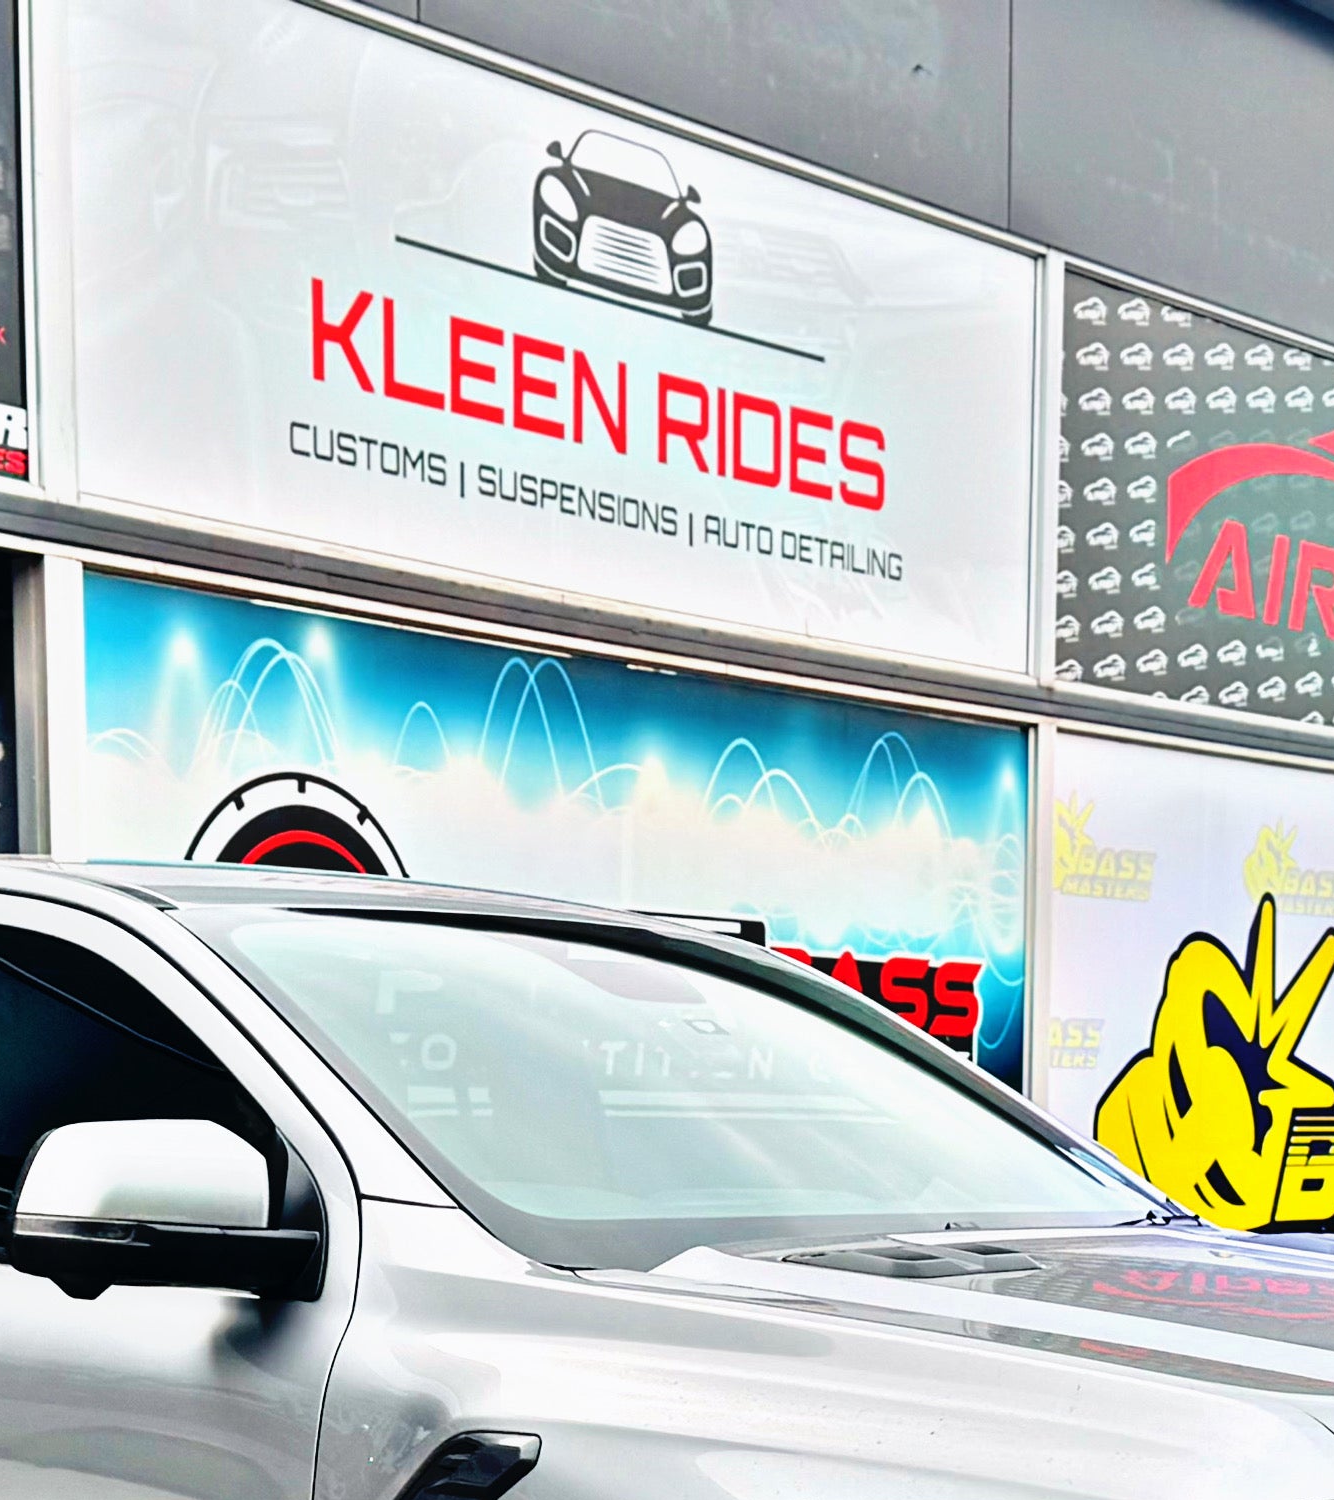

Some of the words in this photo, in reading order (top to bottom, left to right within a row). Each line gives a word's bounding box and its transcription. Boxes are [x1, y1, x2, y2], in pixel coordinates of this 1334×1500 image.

[311, 277, 628, 455] KLEEN
[658, 371, 886, 511] RIDES
[290, 421, 447, 486] CUSTOMS
[478, 464, 677, 536] SUSPENSIONS
[704, 515, 773, 555] AUTO
[781, 530, 903, 581] DETAILING
[1077, 844, 1157, 881] BASS
[771, 947, 984, 1037] ASS
[1048, 1017, 1104, 1049] ASS
